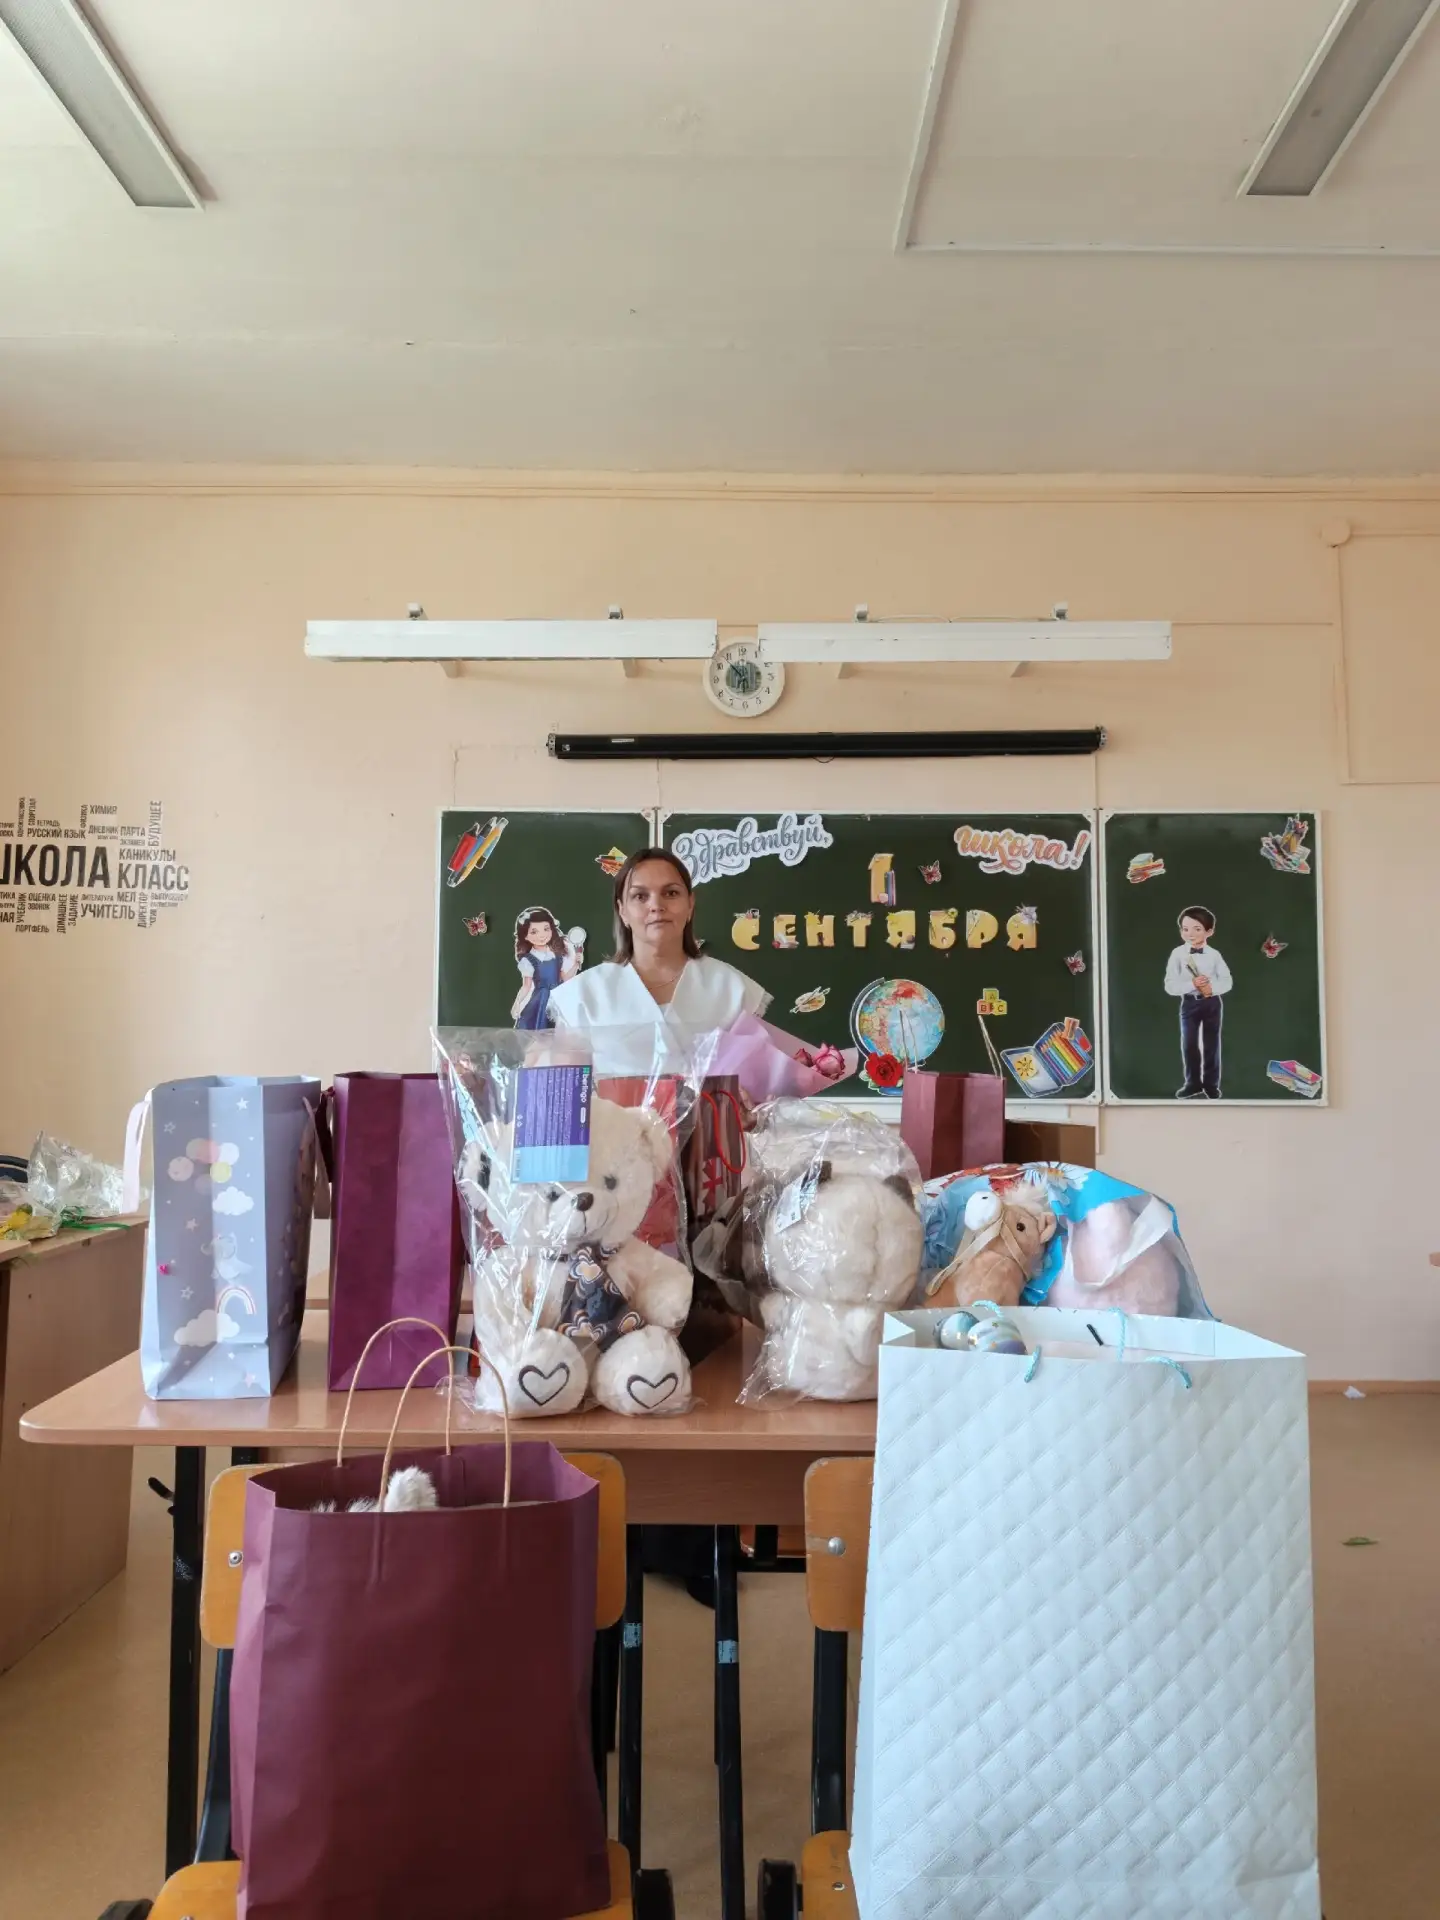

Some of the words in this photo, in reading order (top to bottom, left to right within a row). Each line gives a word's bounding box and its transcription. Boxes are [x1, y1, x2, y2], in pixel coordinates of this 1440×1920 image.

[89, 805, 118, 815] ХИМИЯ
[27, 827, 62, 838] РУССКИЙ
[63, 829, 86, 839] ЯЗЫК
[88, 825, 119, 834] ДНЕВНИК
[120, 826, 146, 837] ПАРТА
[148, 800, 162, 847] БУДУЩЕЕ
[119, 848, 176, 862] КАНИКУЛЫ
[675, 815, 829, 880] Здравствуй,
[117, 862, 190, 891] КЛАСС
[867, 853, 897, 906] 1
[28, 892, 56, 902] ОЦЕНКА
[117, 891, 136, 903] МЕЛ
[56, 893, 68, 934] ДОМАШНЕЕ
[68, 893, 79, 926] ЗАДАНИЕ
[80, 903, 136, 920] УЧИТЕЛЬ
[137, 892, 147, 928] ДИРЕКТОР
[15, 924, 50, 933] ПОРТФЕЛЬ
[731, 903, 1039, 951] СЕНТЯБРЯ
[580, 1073, 590, 1103] berlingo
